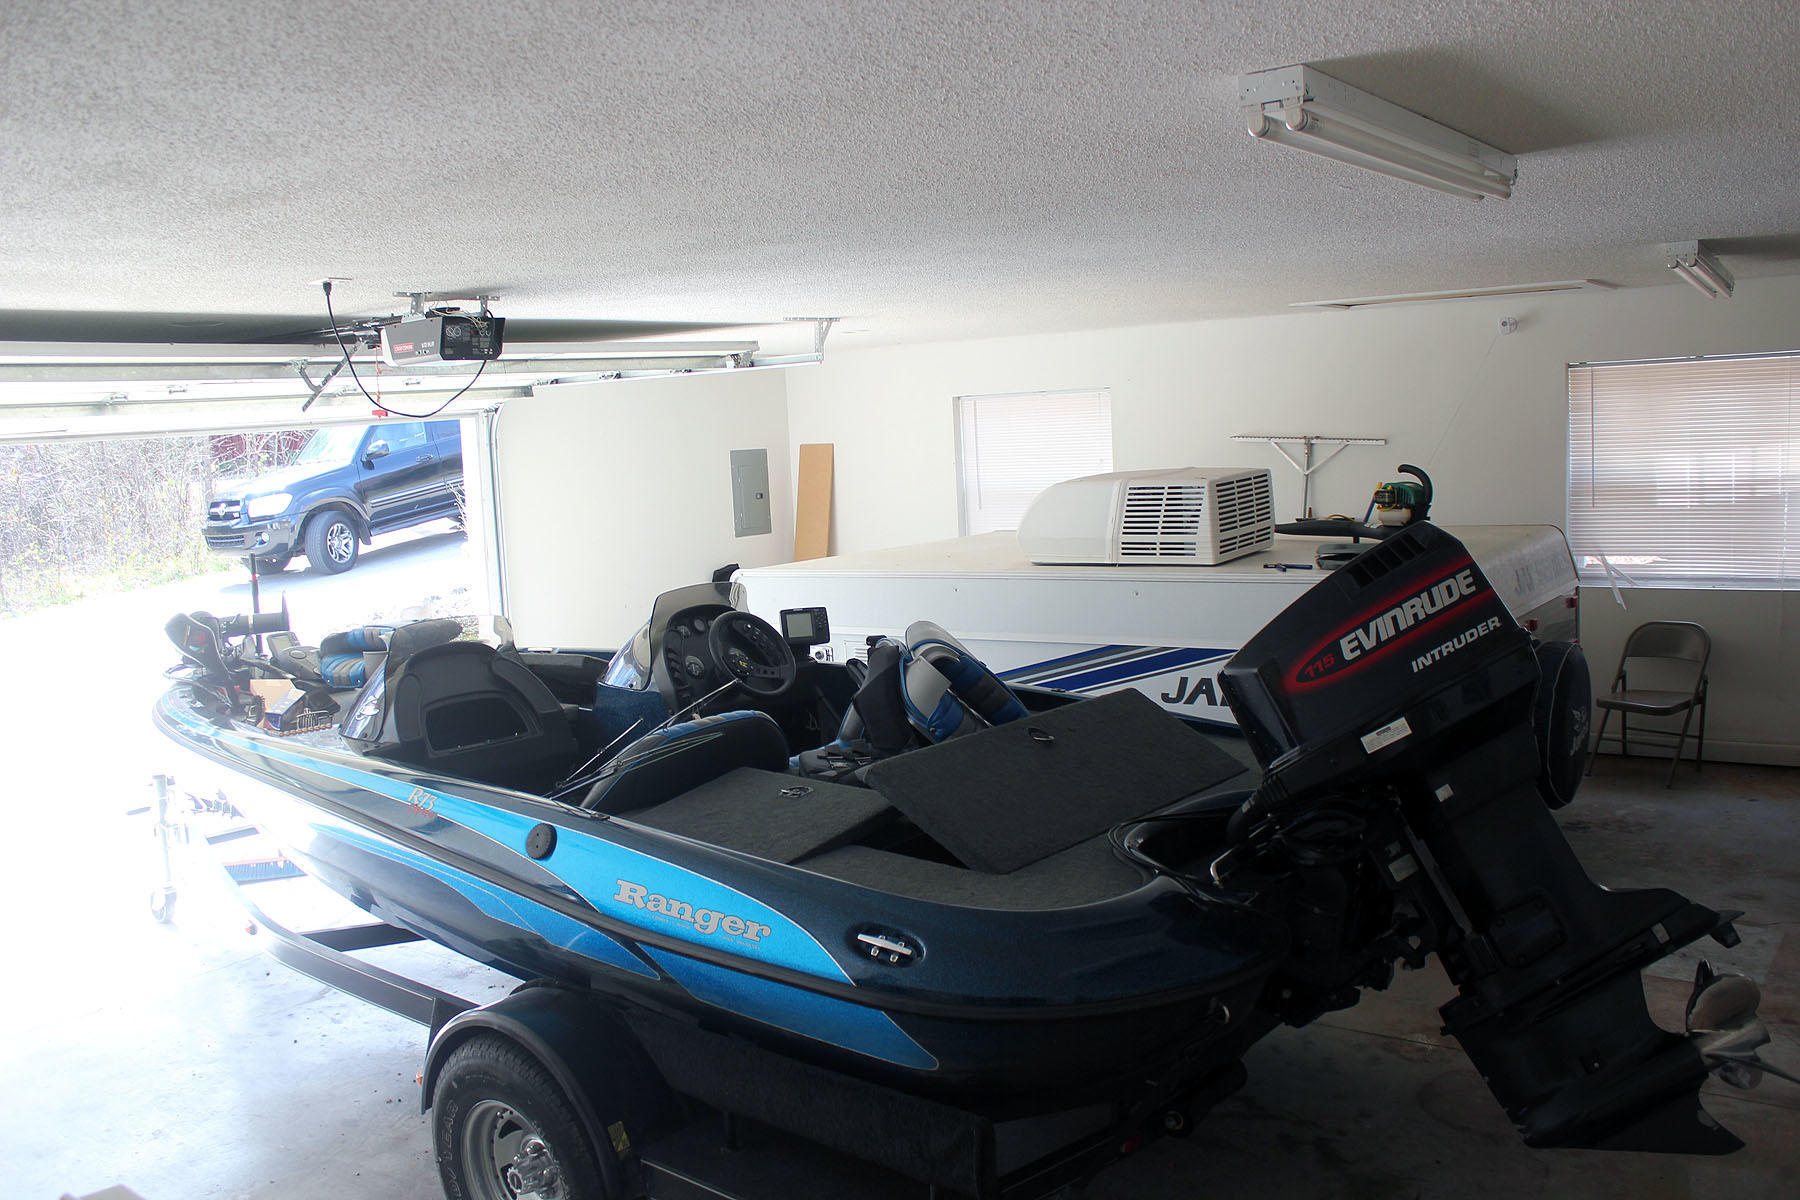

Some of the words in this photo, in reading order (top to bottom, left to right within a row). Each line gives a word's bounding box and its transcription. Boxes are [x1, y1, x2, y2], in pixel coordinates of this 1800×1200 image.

[1304, 652, 1336, 679] 115
[1339, 568, 1477, 662] EVINRUDE
[1411, 615, 1502, 673] INTRUDER
[1160, 676, 1232, 707] JA
[613, 879, 772, 942] Ranger
